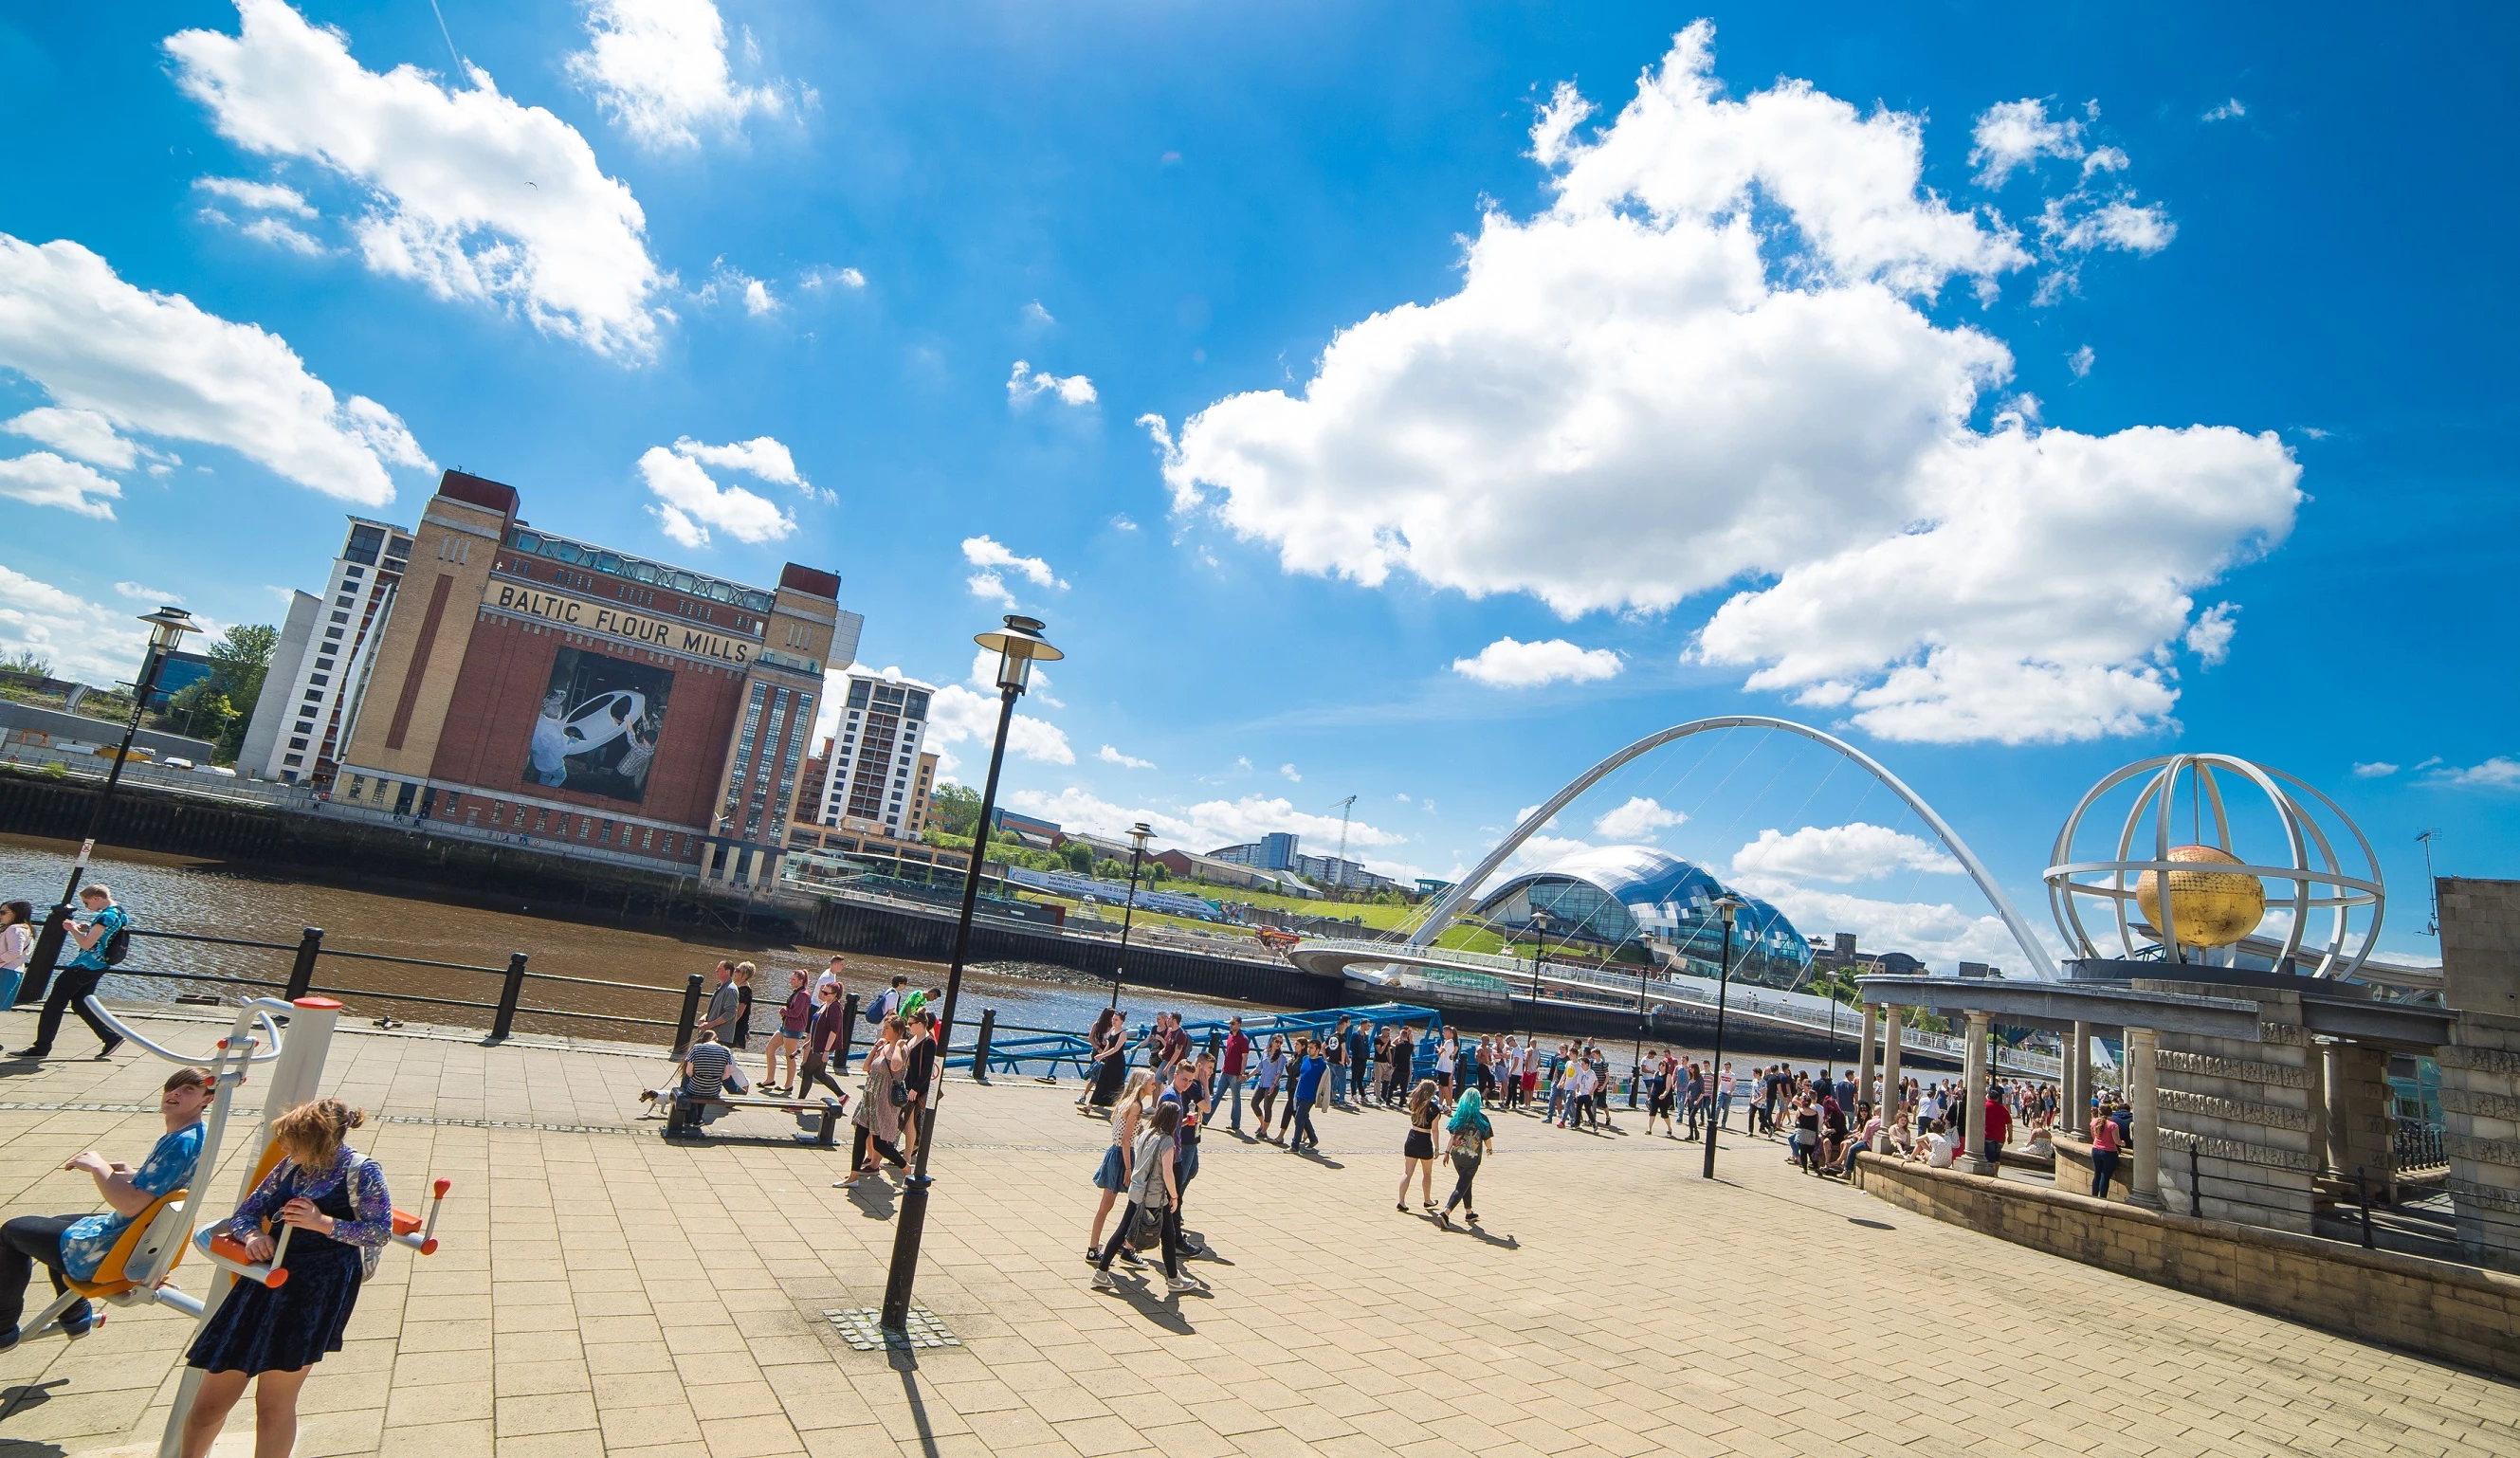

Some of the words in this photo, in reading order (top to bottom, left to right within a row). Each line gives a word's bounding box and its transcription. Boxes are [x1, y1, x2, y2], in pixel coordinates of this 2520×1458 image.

[499, 586, 581, 623] BALTIC
[595, 611, 669, 645] FLOUR
[683, 630, 748, 663] MILLS
[1048, 881, 1067, 889] Athletics
